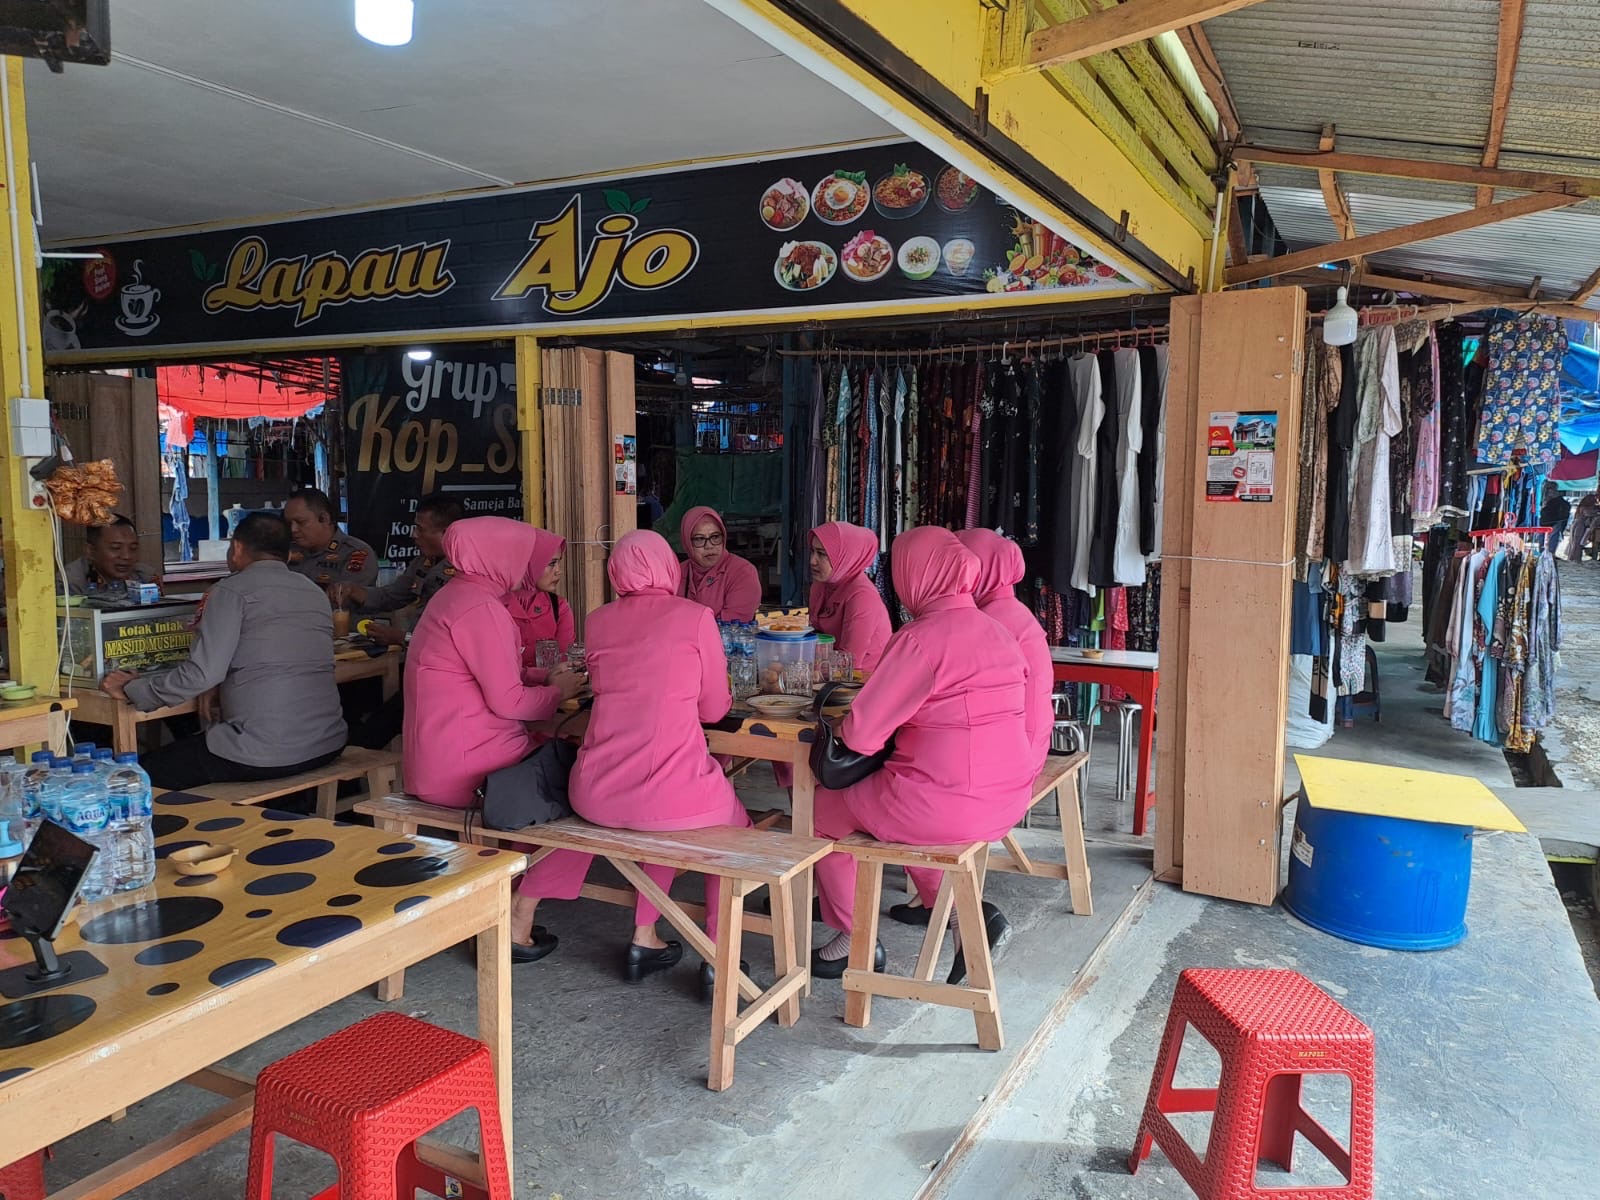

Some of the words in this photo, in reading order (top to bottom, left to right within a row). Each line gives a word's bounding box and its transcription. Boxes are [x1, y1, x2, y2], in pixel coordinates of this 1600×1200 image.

[204, 237, 455, 326] Lapau
[492, 194, 698, 314] Ajo
[463, 497, 504, 511] Sameja
[508, 496, 524, 509] Ba
[119, 624, 152, 637] Kotak
[105, 638, 146, 658] MASJID
[77, 809, 106, 822] AQUA
